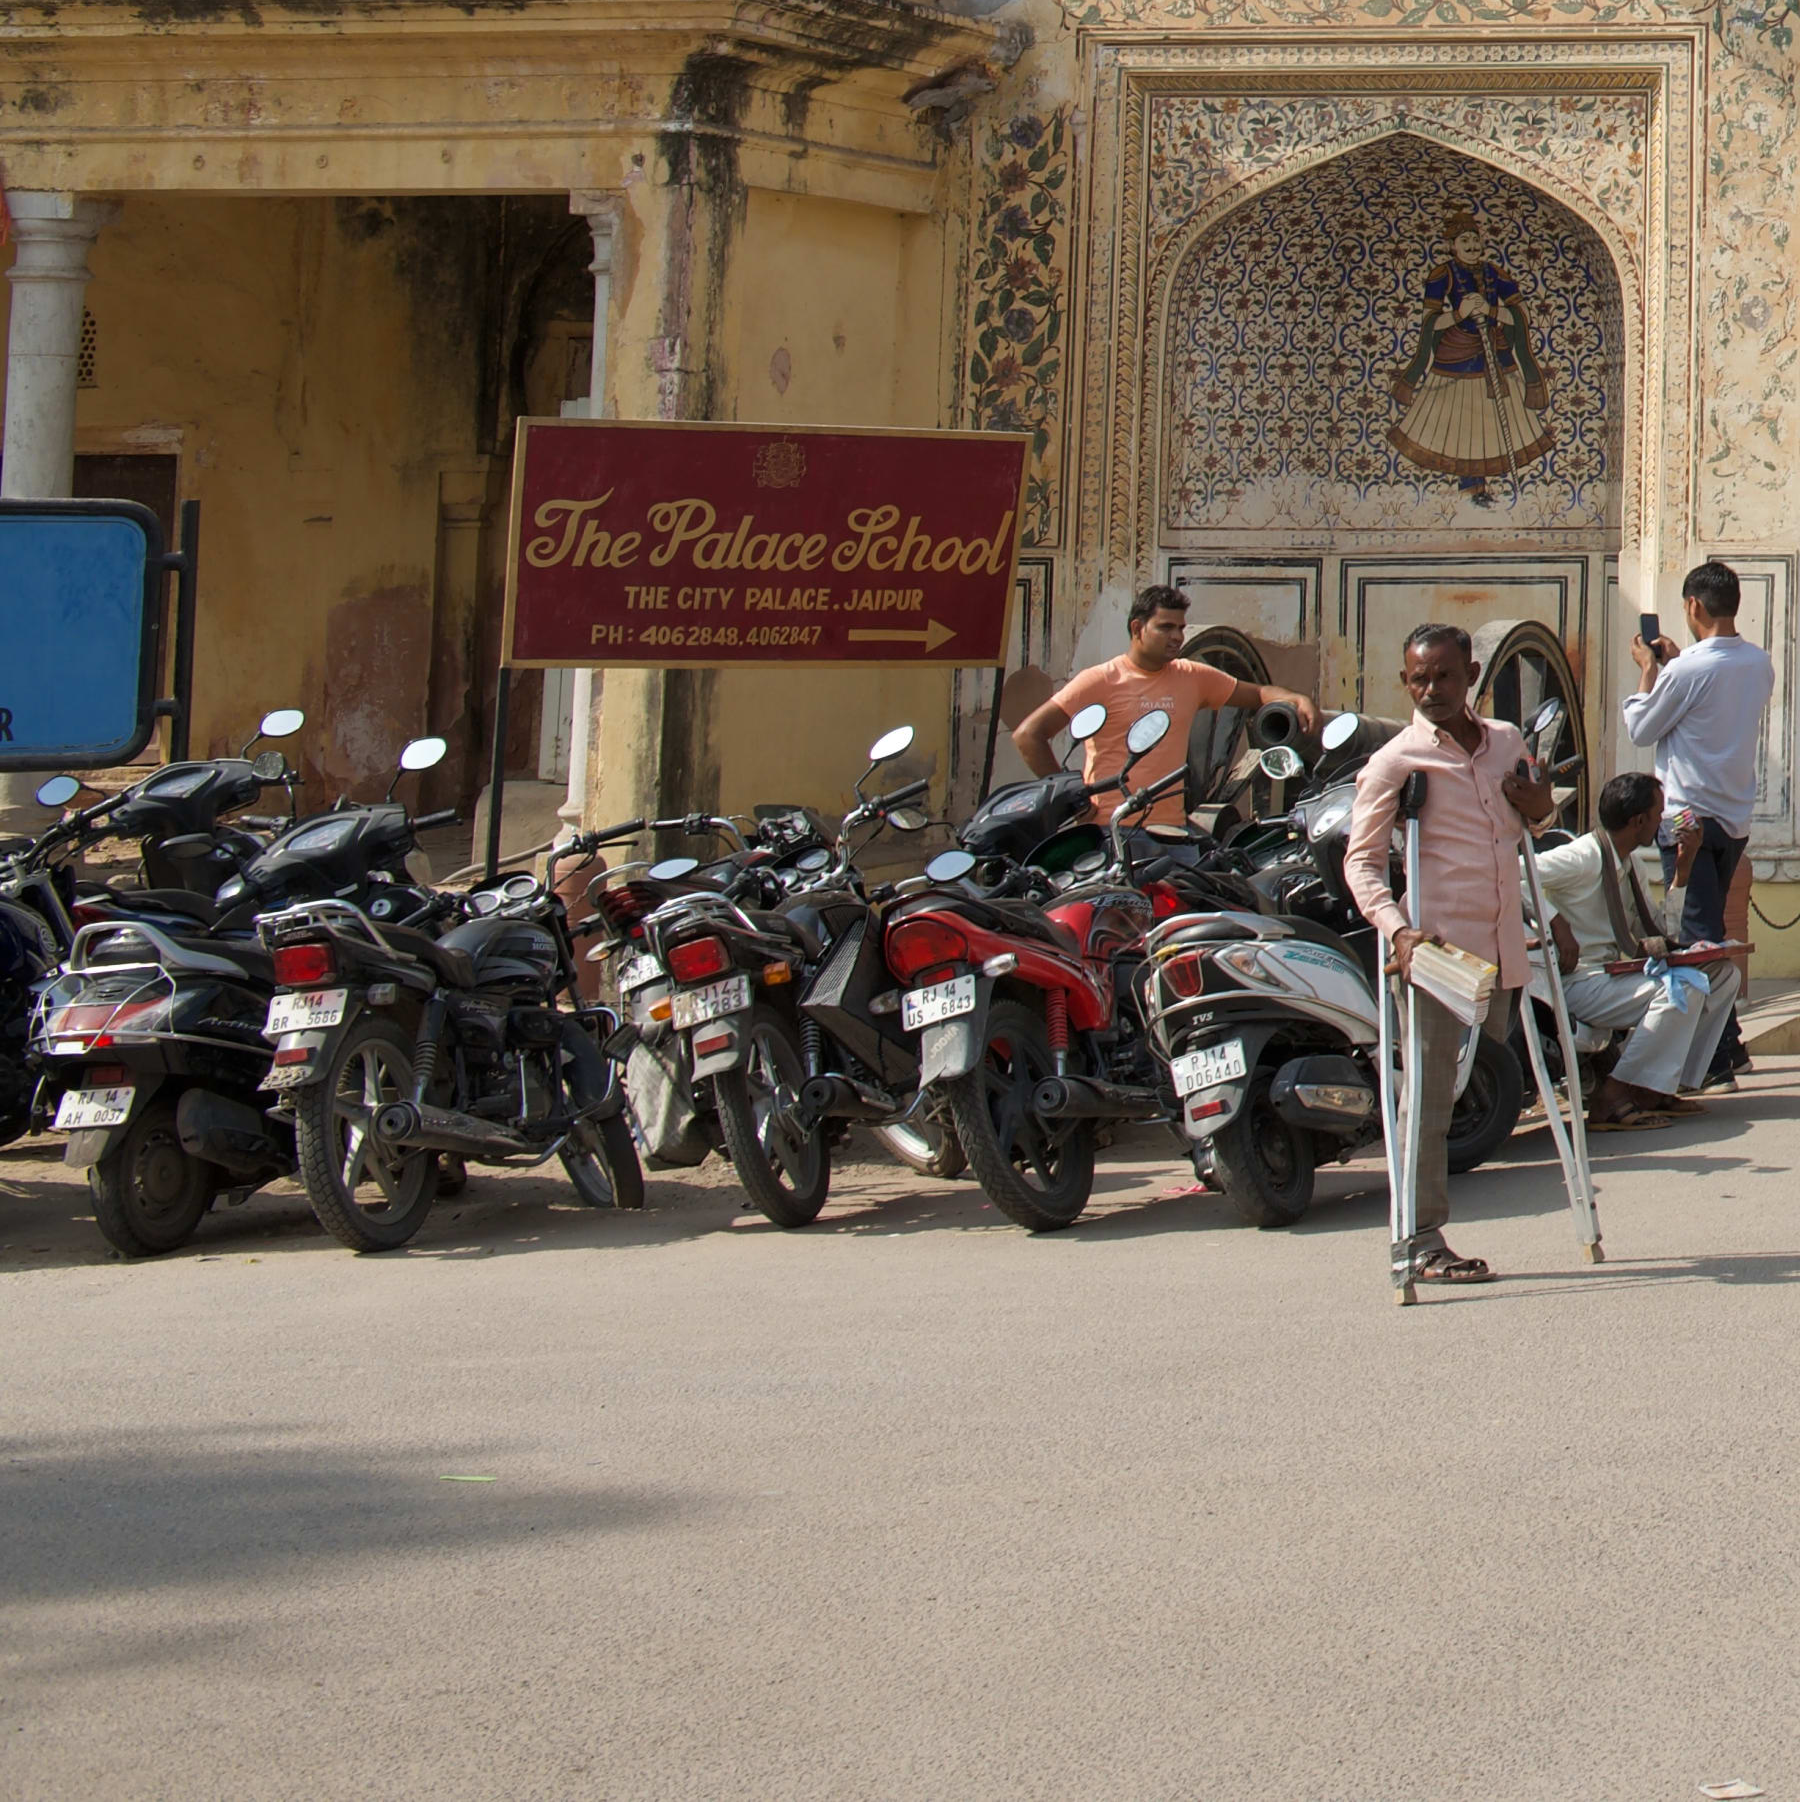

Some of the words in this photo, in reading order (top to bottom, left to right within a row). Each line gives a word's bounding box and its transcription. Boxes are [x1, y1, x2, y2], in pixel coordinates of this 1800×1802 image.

[526, 487, 641, 568] The
[647, 497, 828, 572] Palace
[831, 503, 1015, 575] School
[624, 586, 669, 610] THE
[676, 587, 735, 611] CITY
[1140, 701, 1174, 710] MIAMI
[292, 993, 324, 1011] RJ14
[922, 987, 937, 1005] RJ
[944, 982, 957, 998] 14
[272, 1016, 289, 1031] BR
[307, 1009, 339, 1026] 5686
[908, 1009, 924, 1027] US
[941, 994, 971, 1016] 6843
[1192, 1011, 1214, 1026] TVS
[1191, 1045, 1227, 1071] RJ14
[1185, 1058, 1242, 1091] D06440
[77, 1090, 96, 1105] RJ
[104, 1089, 119, 1104] 14
[63, 1111, 84, 1126] AH
[93, 1107, 125, 1123] 0037
